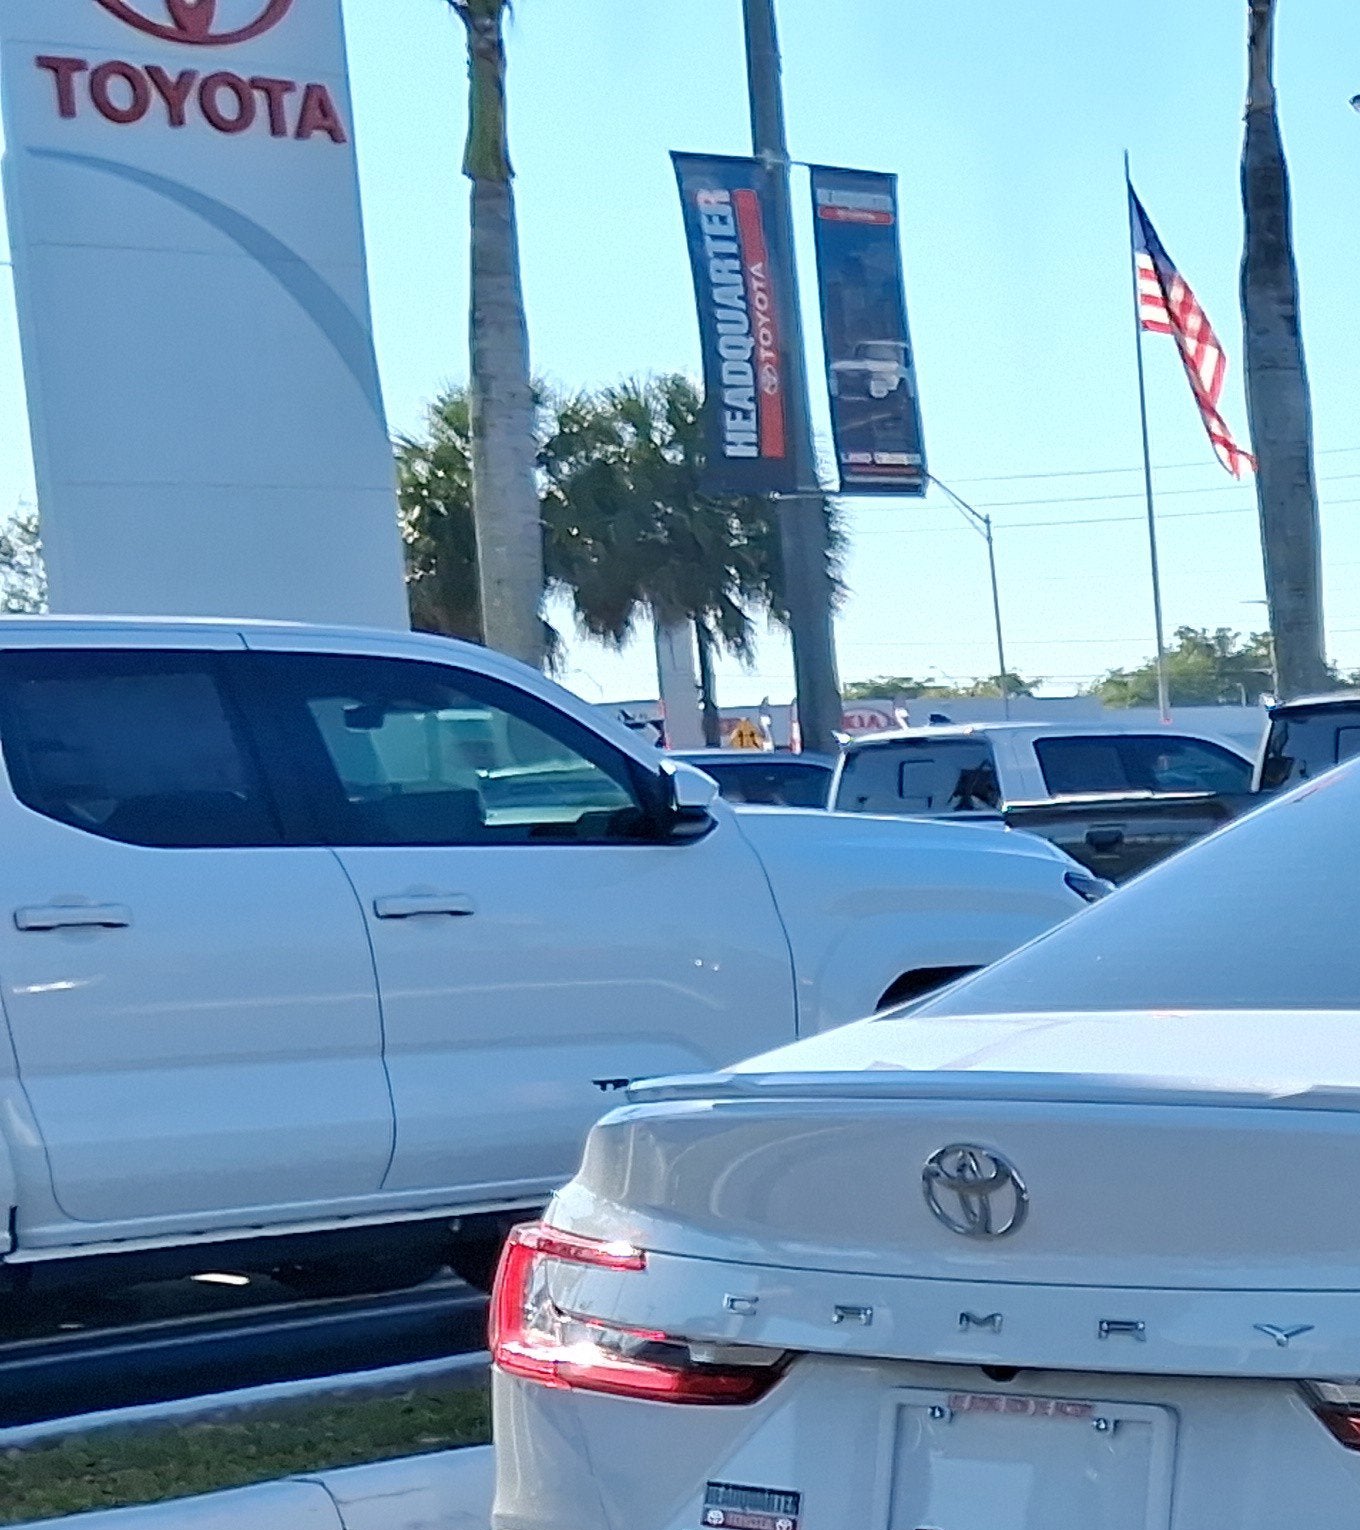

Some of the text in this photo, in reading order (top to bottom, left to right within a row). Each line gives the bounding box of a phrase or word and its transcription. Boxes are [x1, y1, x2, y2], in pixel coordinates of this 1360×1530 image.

[34, 54, 347, 144] TOYOTA
[696, 188, 759, 459] HEADQUARTER
[750, 261, 777, 362] TOYOTA
[722, 1291, 1315, 1348] CAMRY
